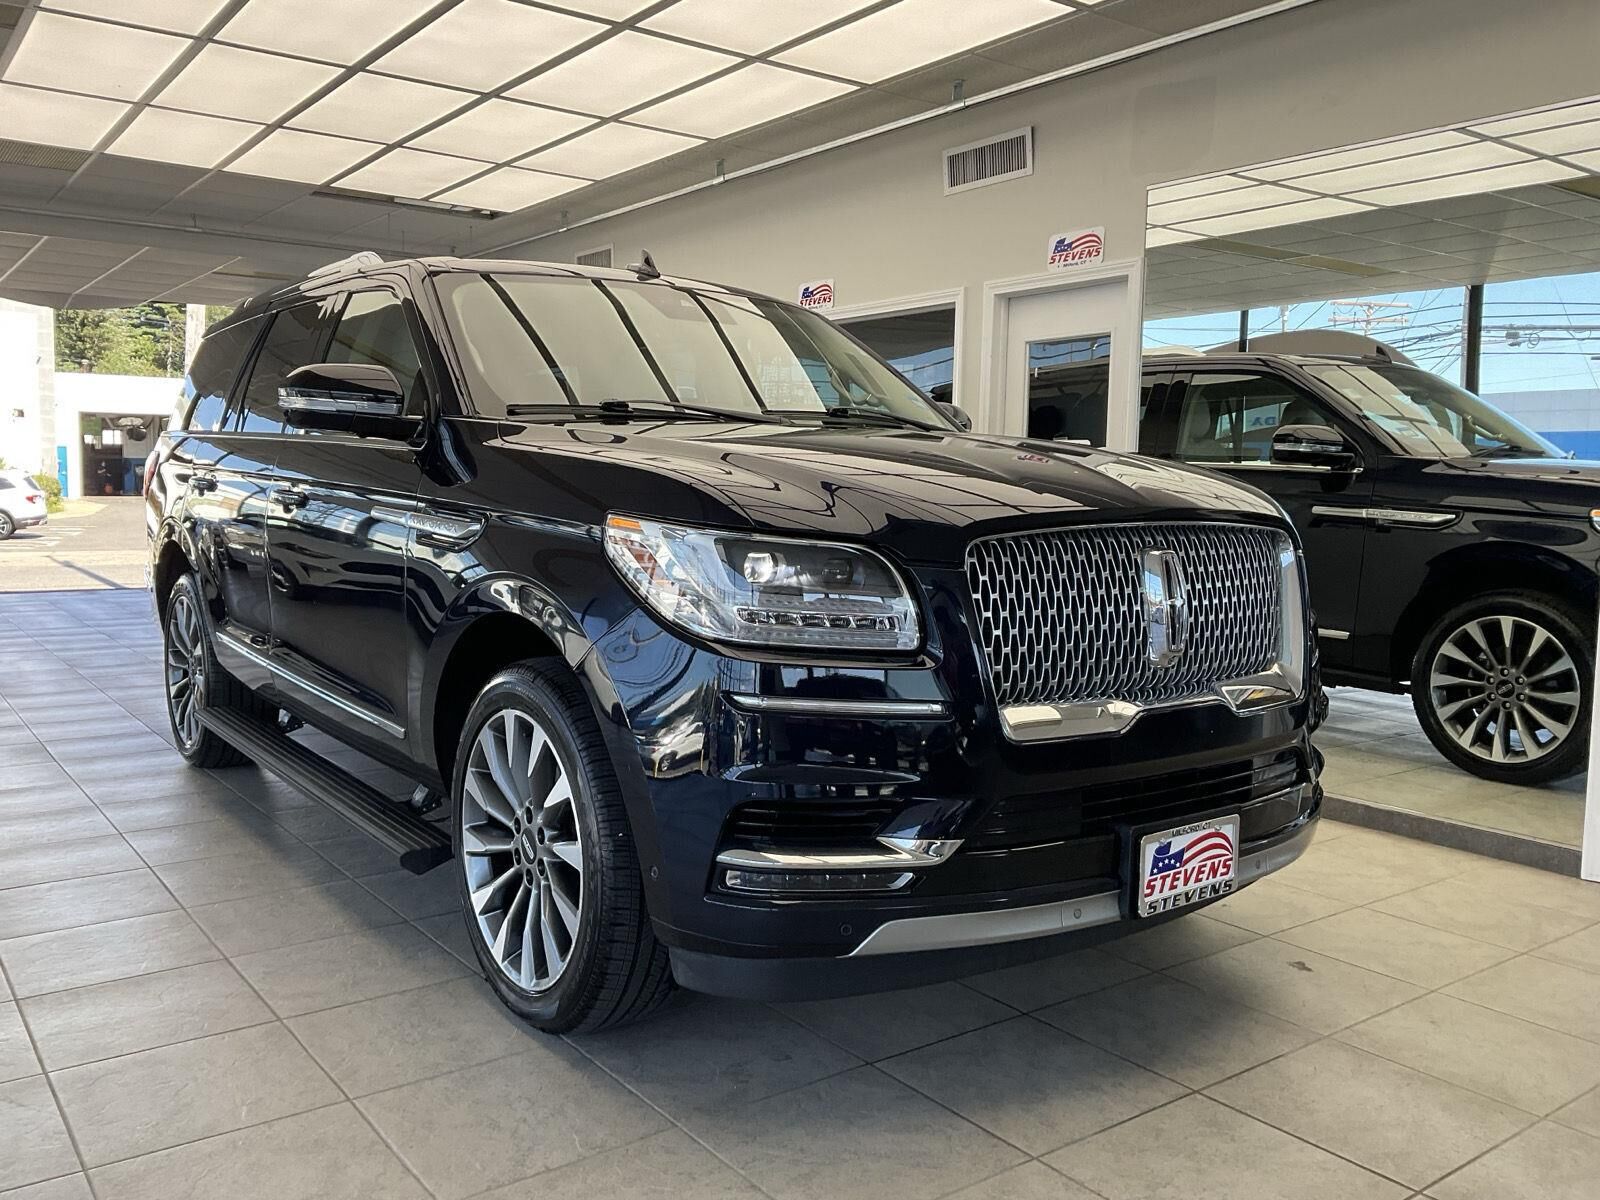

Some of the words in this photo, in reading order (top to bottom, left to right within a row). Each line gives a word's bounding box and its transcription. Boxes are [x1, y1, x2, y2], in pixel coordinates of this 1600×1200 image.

[1049, 247, 1102, 265] STEVENS
[800, 295, 832, 306] STEVENS
[1144, 857, 1234, 898] STEVENS
[1146, 880, 1234, 916] STEVENS
